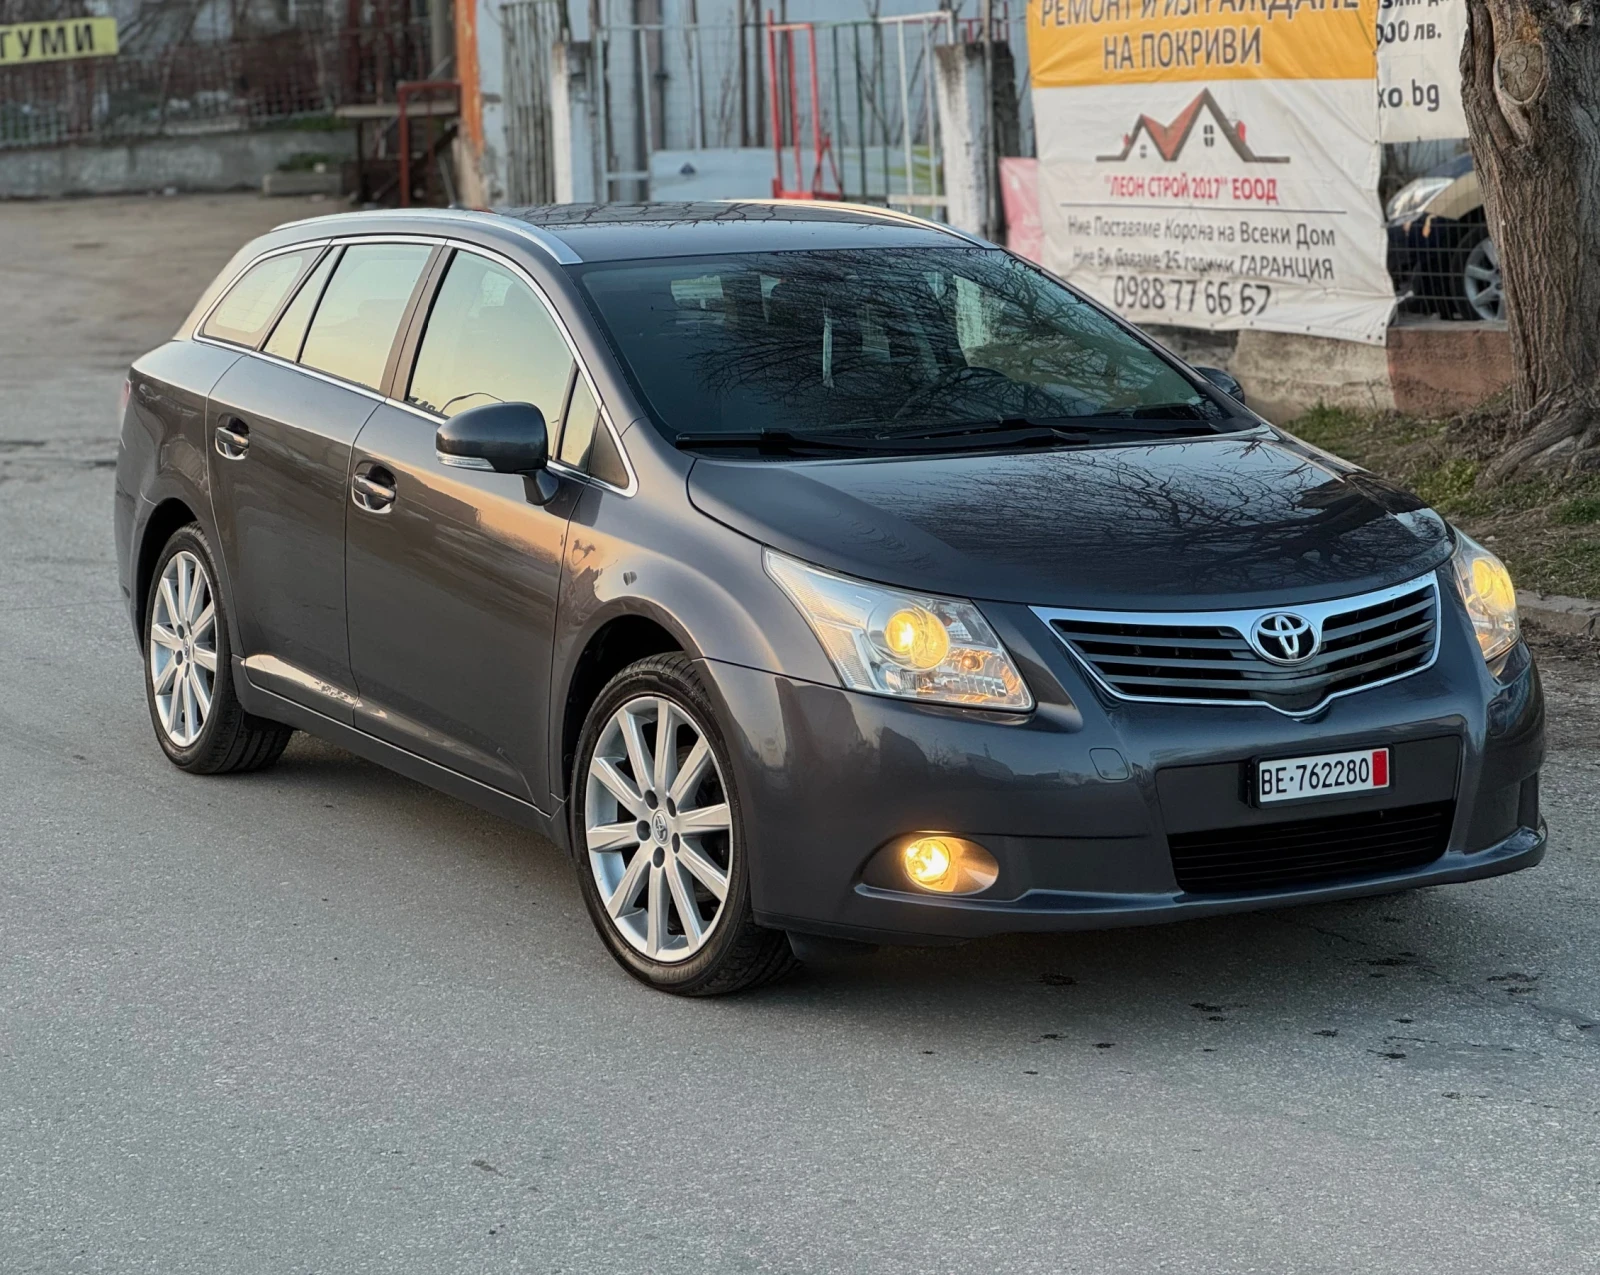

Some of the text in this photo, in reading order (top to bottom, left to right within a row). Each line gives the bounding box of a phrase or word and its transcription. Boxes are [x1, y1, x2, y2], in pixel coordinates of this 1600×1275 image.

[0, 24, 94, 59] ГУМИ
[1104, 26, 1261, 70] НА ПОКРИВИ
[1413, 22, 1442, 41] лв.
[1148, 172, 1190, 198] СТРОЙ
[1231, 177, 1279, 206] ЕООД
[1067, 215, 1336, 250] Ние Поставяме Корона на Всеки Дом
[1239, 254, 1335, 284] ГАРАНЦИЯ
[1113, 275, 1271, 317] 0988 77 66 67
